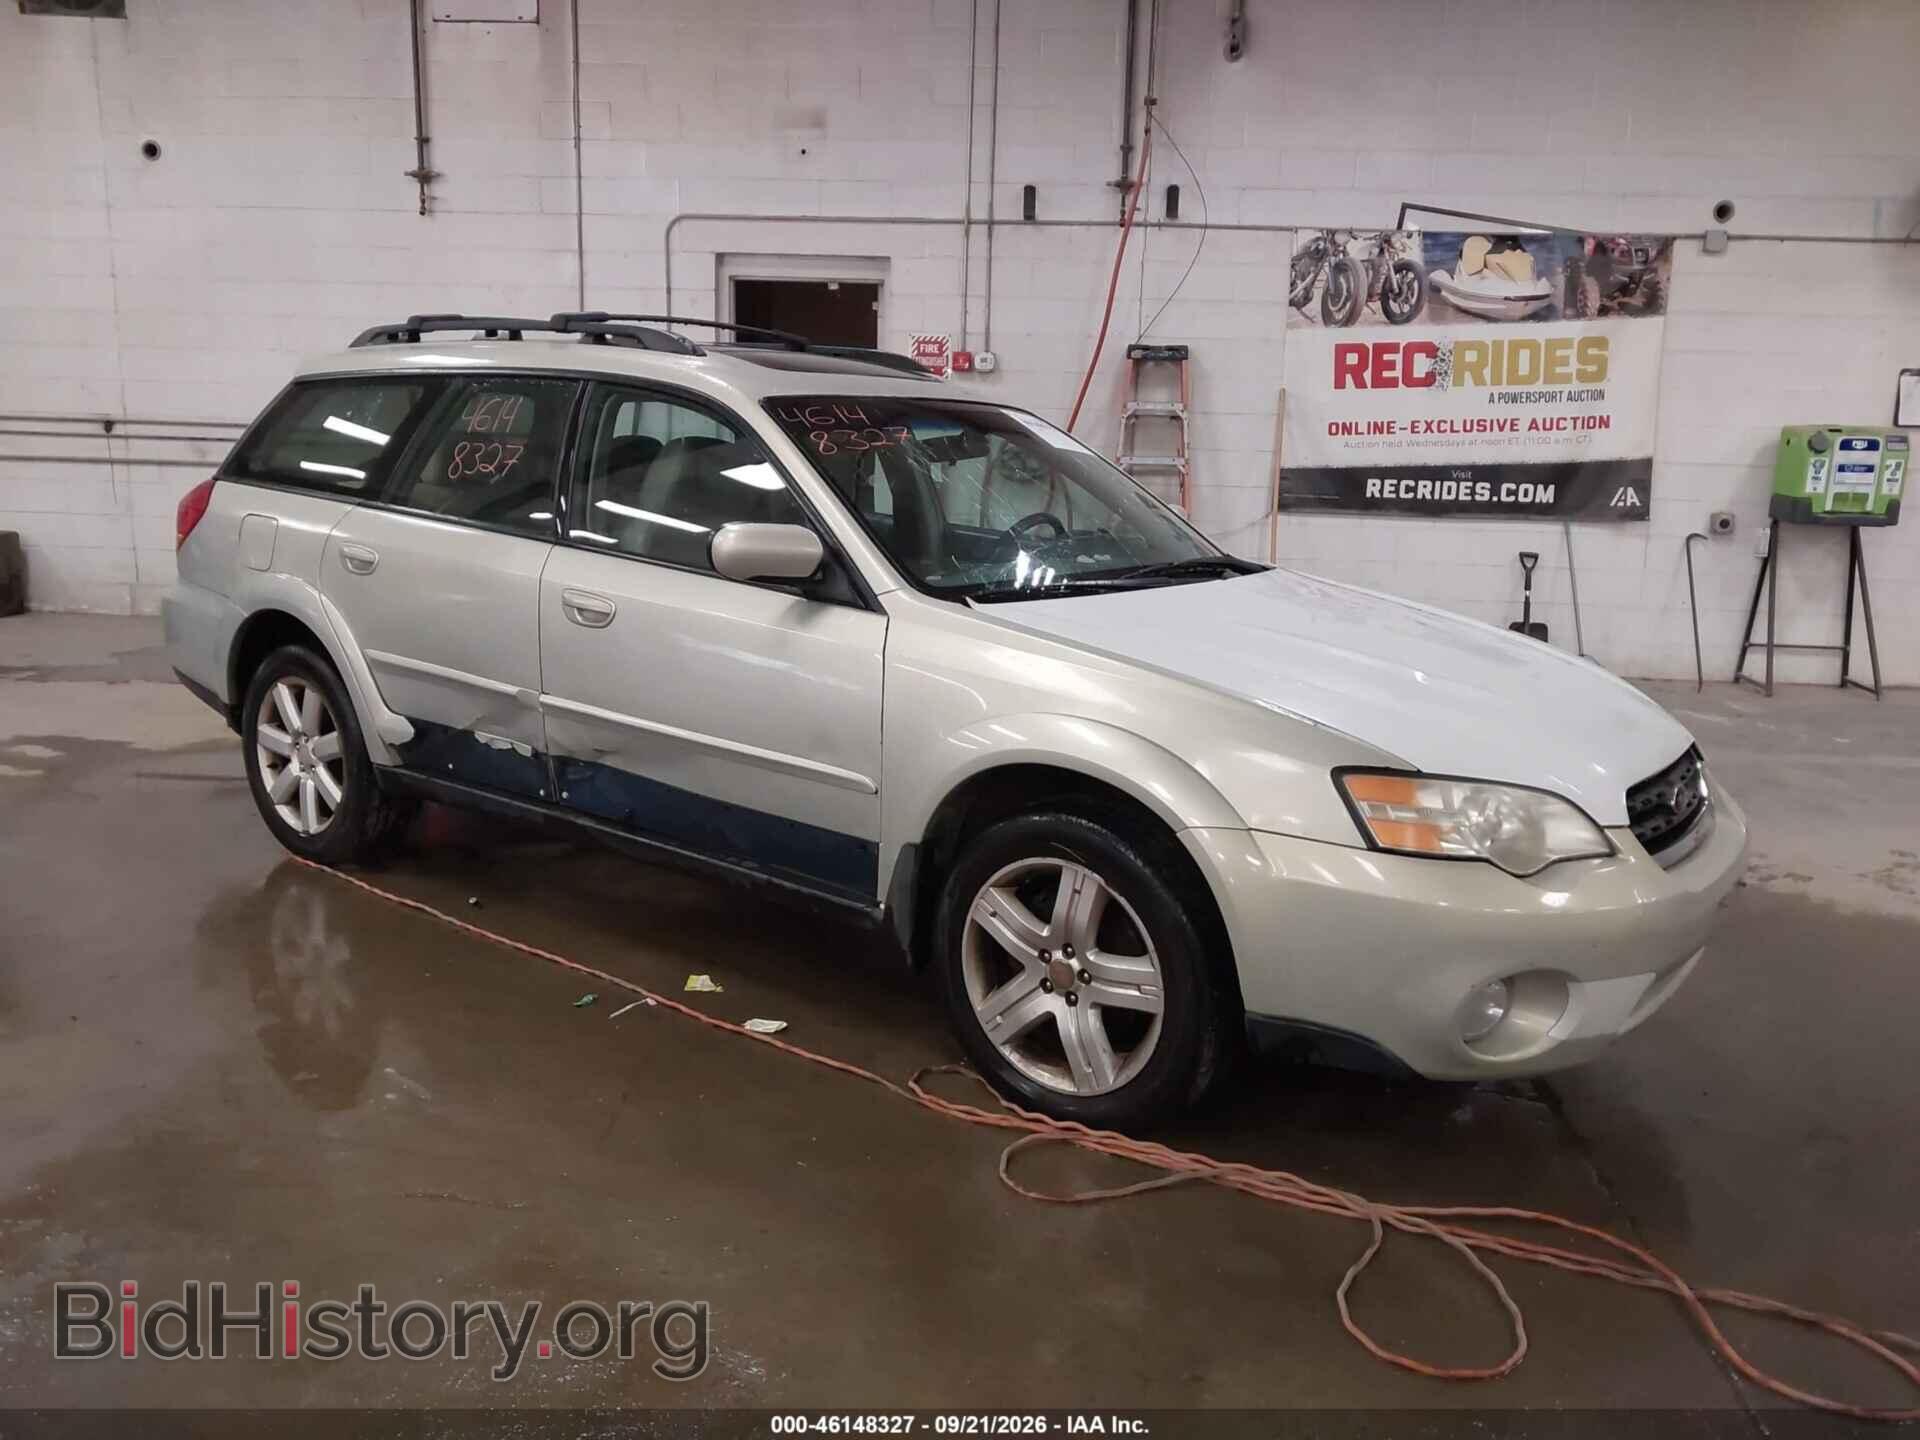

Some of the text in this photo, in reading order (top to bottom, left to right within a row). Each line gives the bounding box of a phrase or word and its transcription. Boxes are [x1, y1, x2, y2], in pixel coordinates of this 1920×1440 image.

[919, 343, 940, 354] FIRE
[1334, 335, 1609, 390] REC RIDES
[1488, 388, 1606, 404] A POWERSPORT AUCTION
[461, 395, 524, 433] 4614
[777, 404, 871, 429] 4614
[1327, 415, 1611, 437] ONLINE-EXCLUSIVE AUCTION
[809, 426, 912, 455] 8327
[1343, 439, 1380, 449] Auction
[448, 441, 524, 480] 8327
[1365, 478, 1555, 505] RECRIDES.COM
